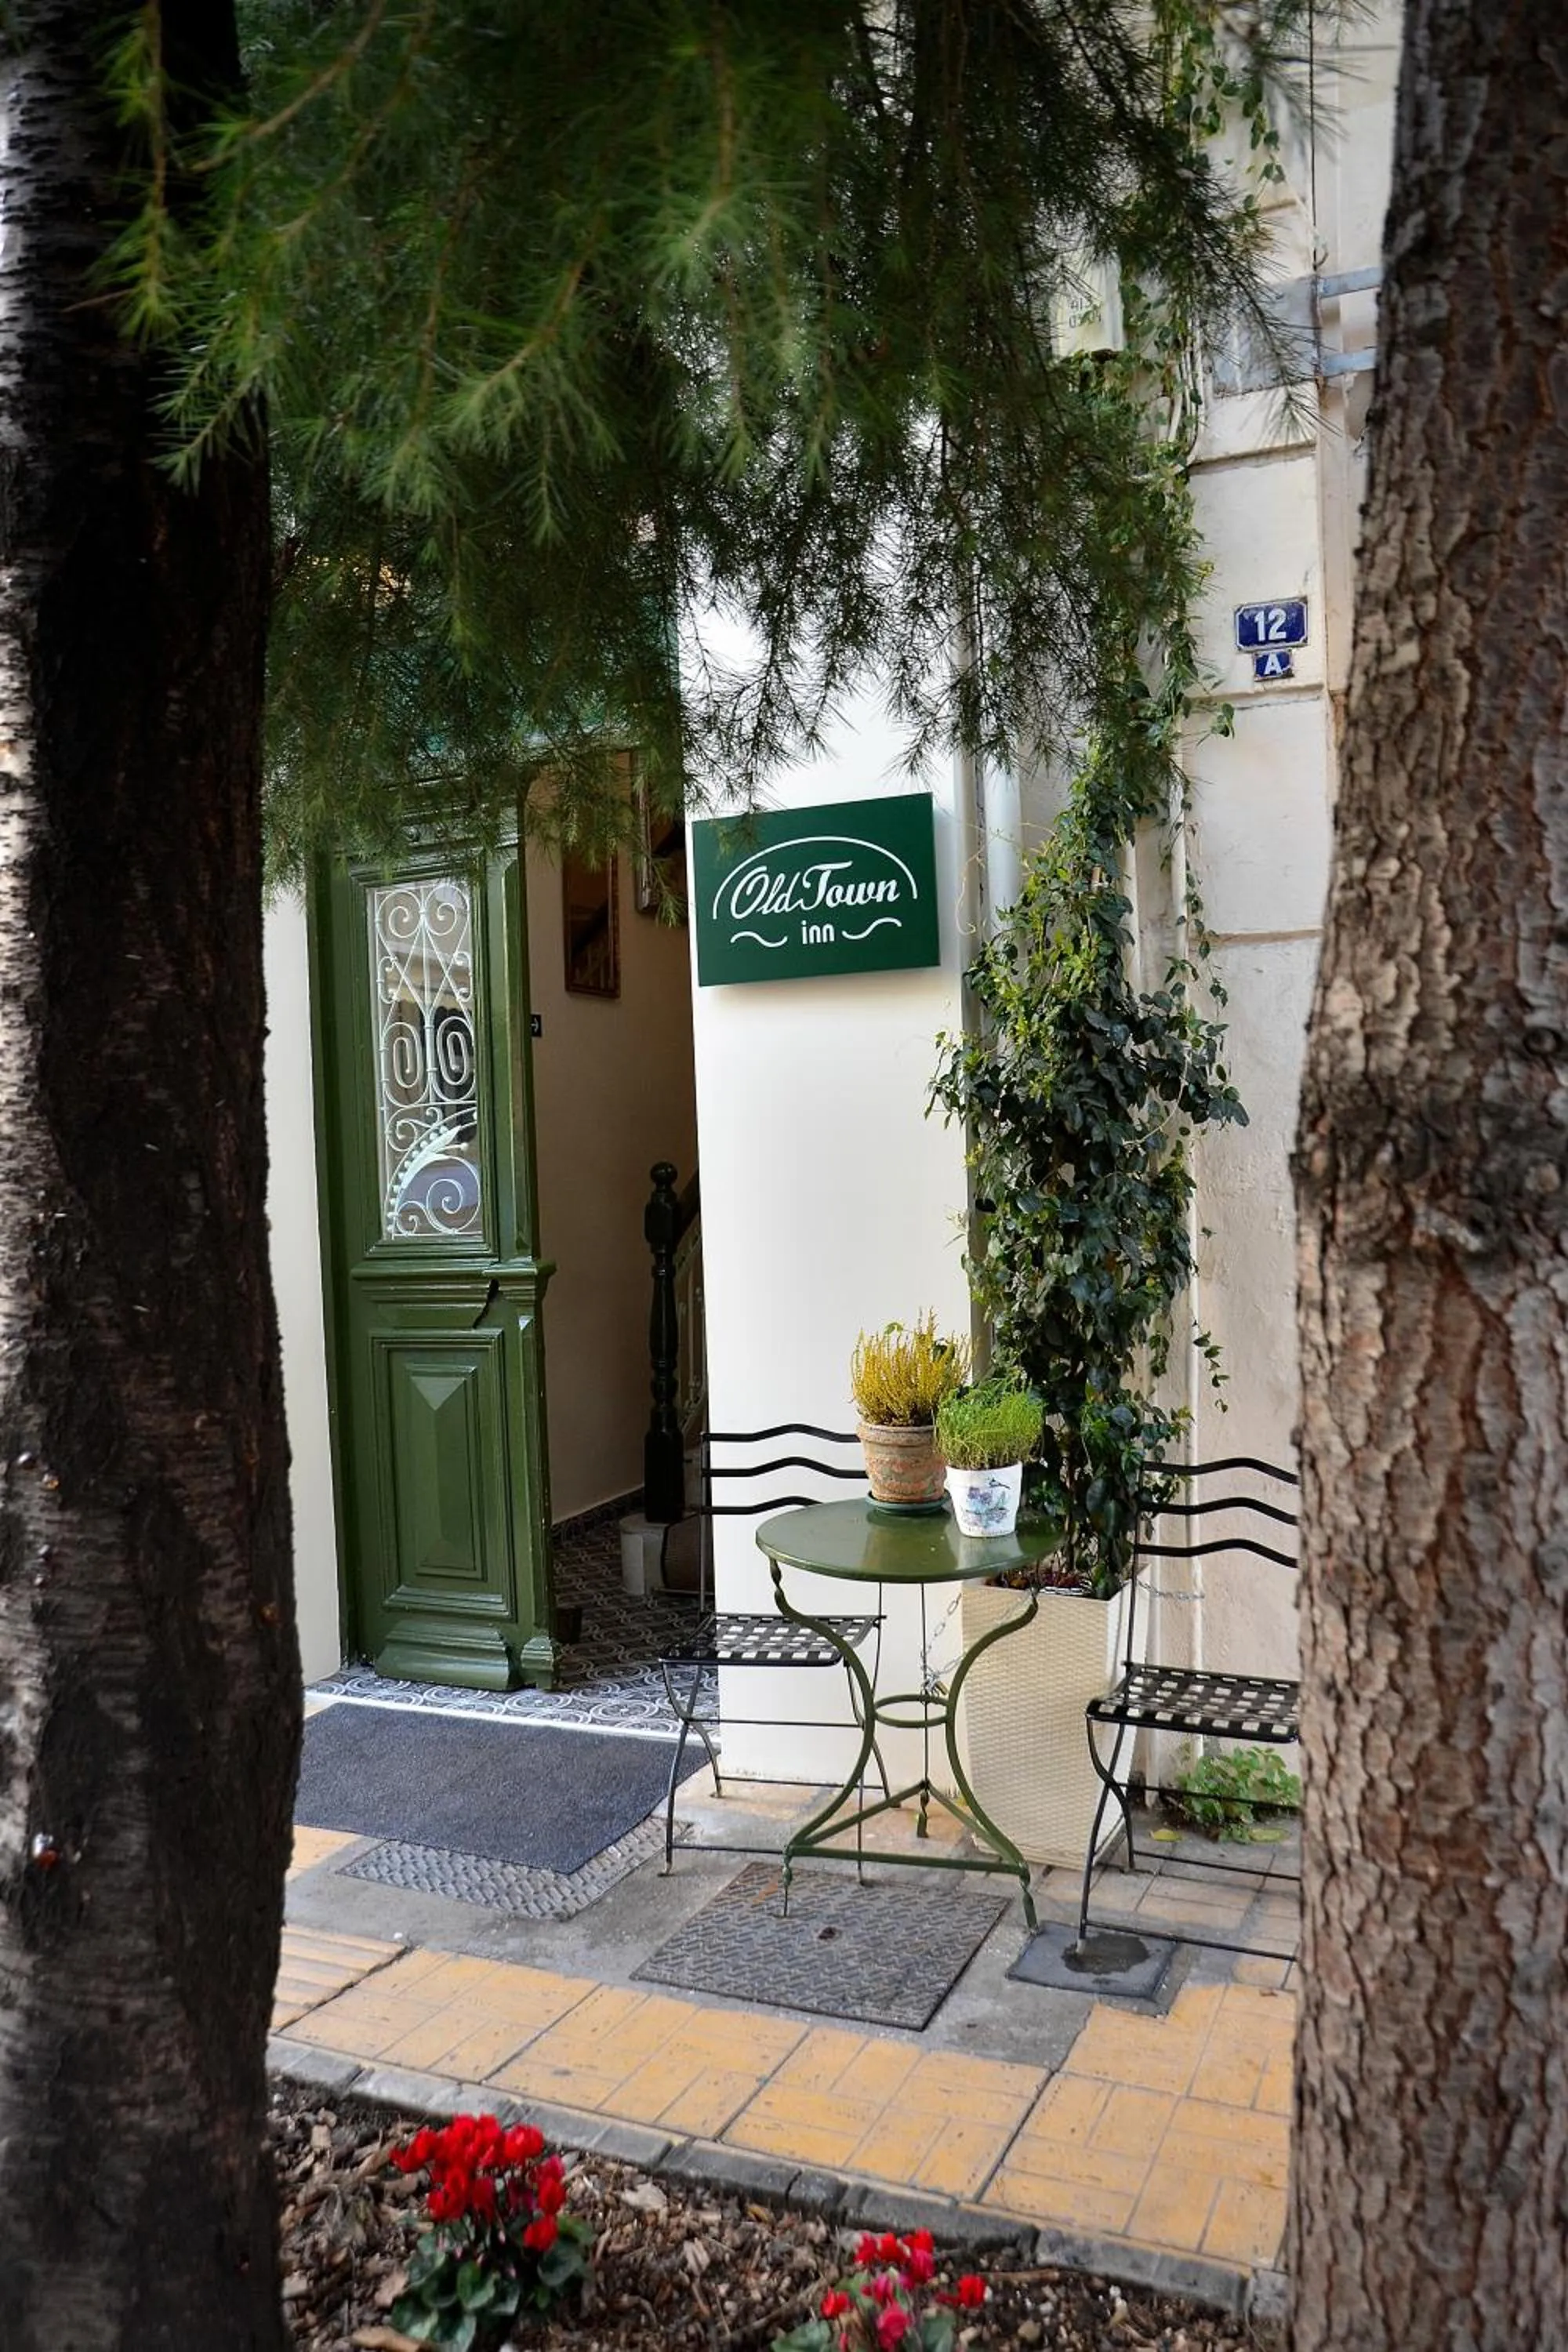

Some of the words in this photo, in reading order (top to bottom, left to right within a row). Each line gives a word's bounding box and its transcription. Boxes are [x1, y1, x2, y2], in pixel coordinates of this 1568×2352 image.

[1254, 608, 1287, 641] 12
[1263, 652, 1283, 675] A
[730, 865, 803, 920] Old
[800, 860, 901, 911] Town
[801, 920, 835, 945] inn
